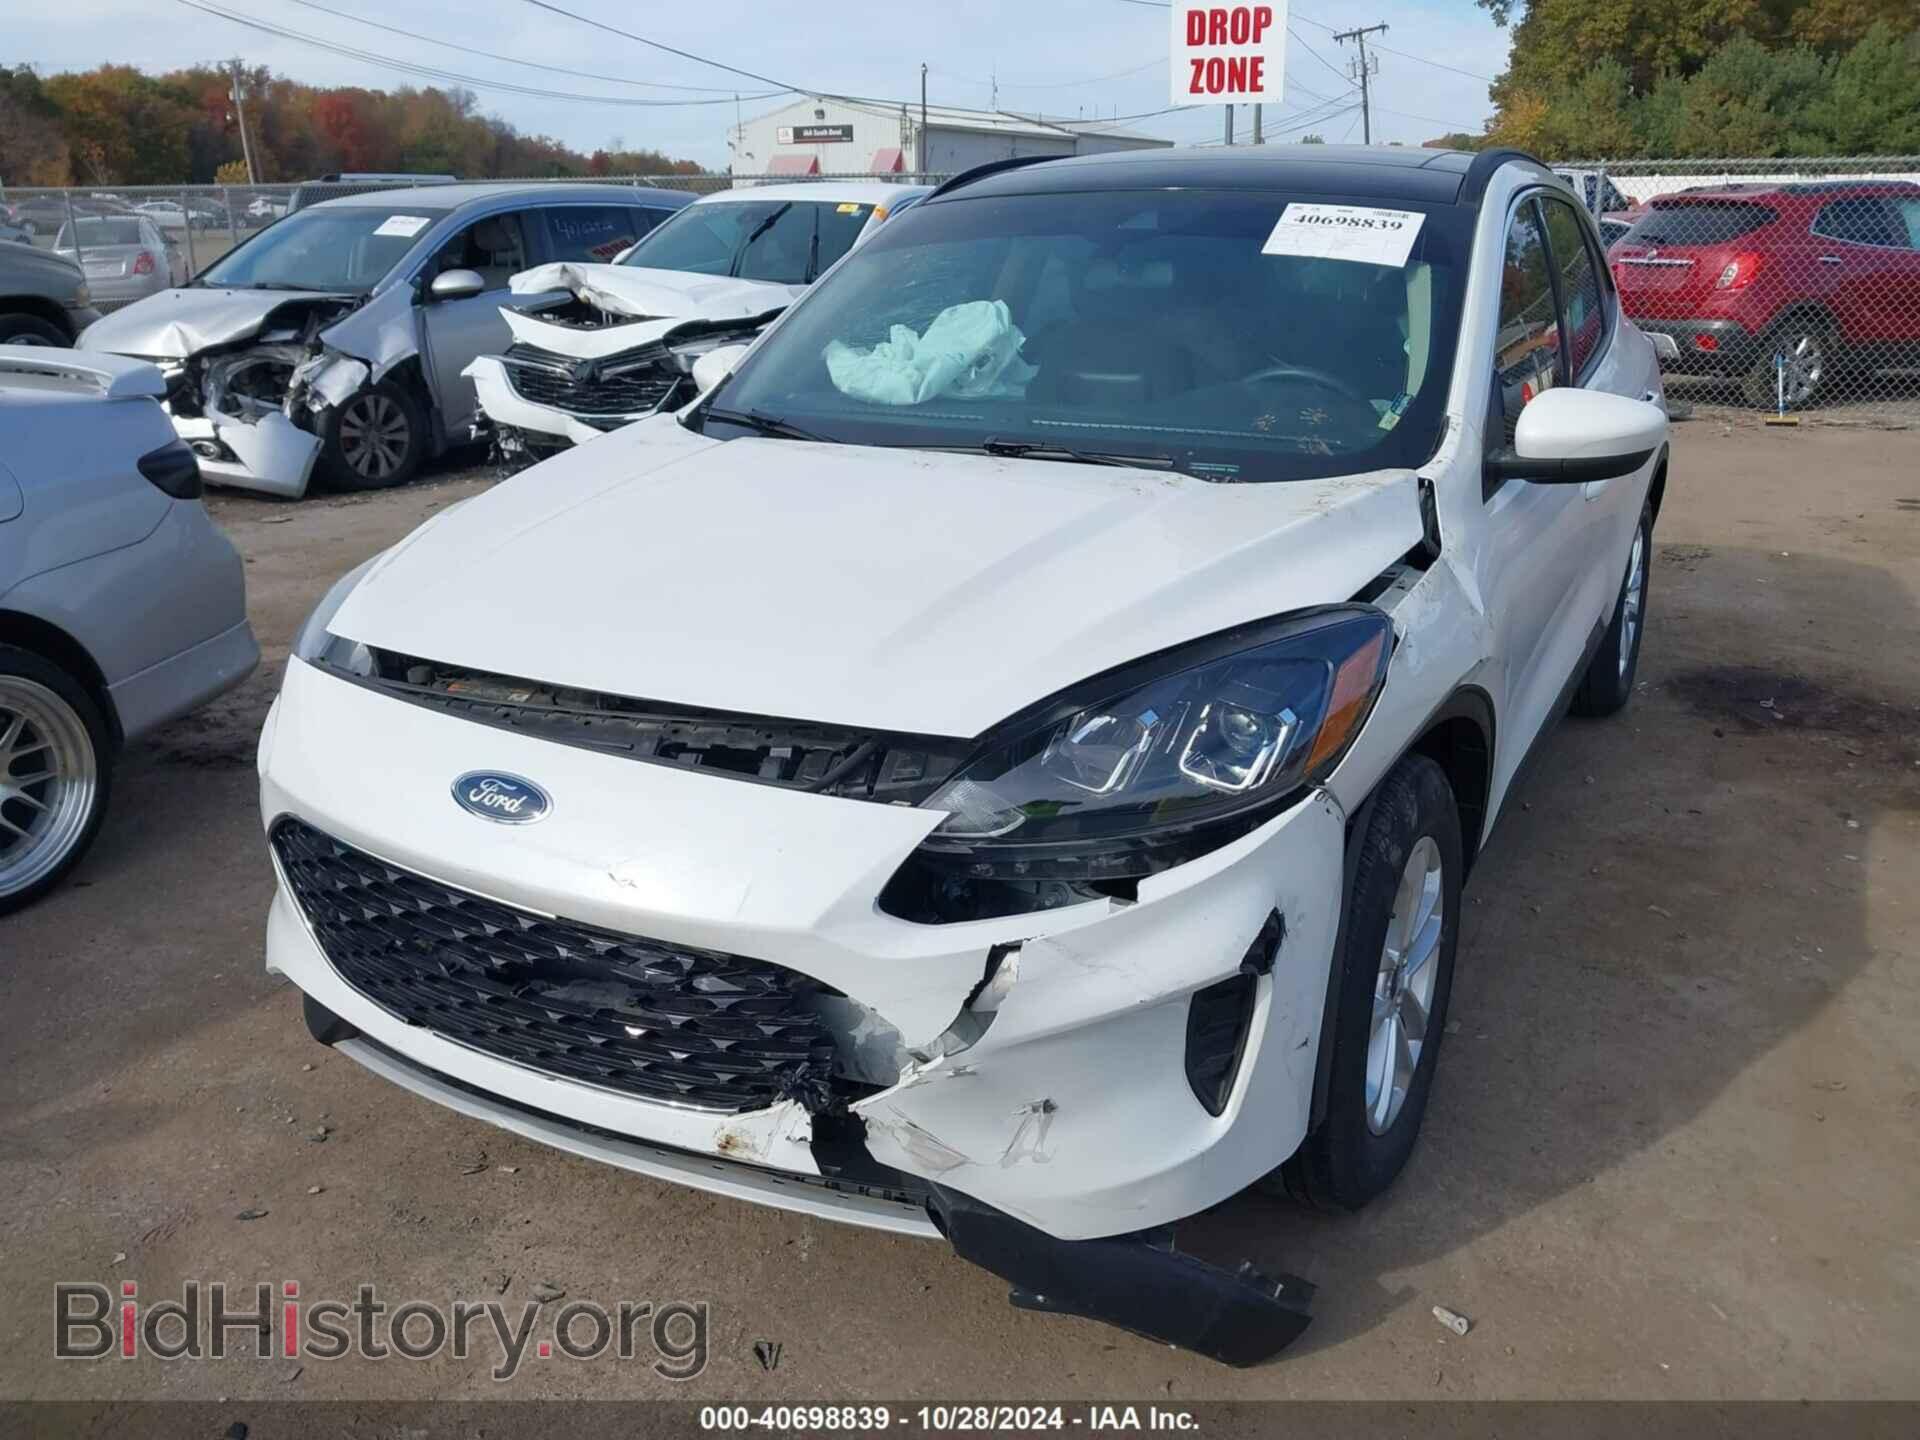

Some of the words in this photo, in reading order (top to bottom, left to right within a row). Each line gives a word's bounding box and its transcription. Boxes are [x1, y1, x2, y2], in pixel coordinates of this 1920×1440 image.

[1186, 6, 1273, 46] DROP
[1189, 56, 1265, 94] ZONE
[1294, 213, 1404, 232] 40698839
[469, 778, 528, 813] Ford
